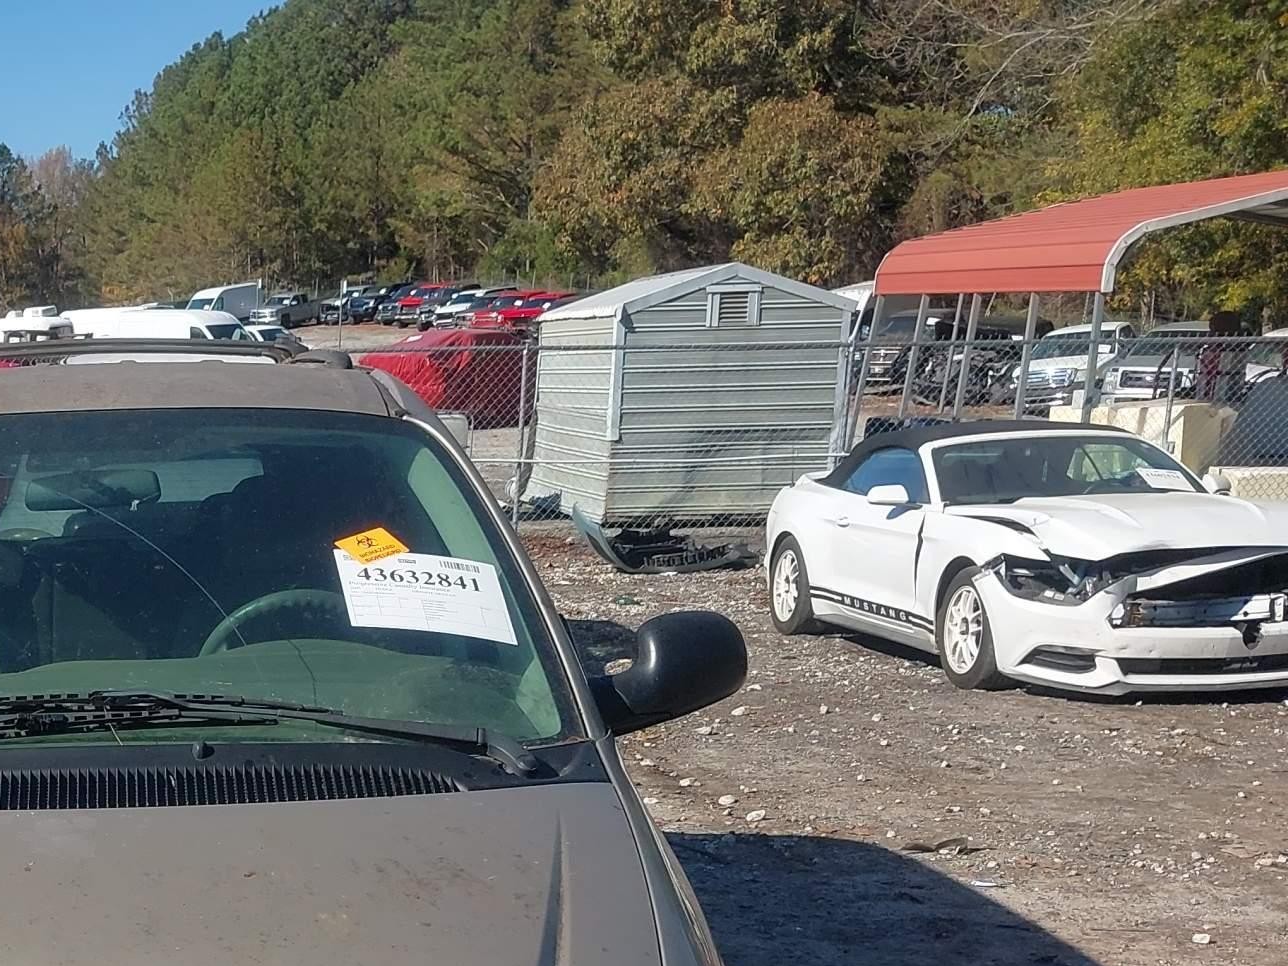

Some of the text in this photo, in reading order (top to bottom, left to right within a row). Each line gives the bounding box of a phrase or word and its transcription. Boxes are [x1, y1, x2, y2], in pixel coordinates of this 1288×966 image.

[359, 544, 395, 558] BIOHAZARD
[357, 567, 481, 592] 43632841
[844, 596, 907, 621] MUSTANG
